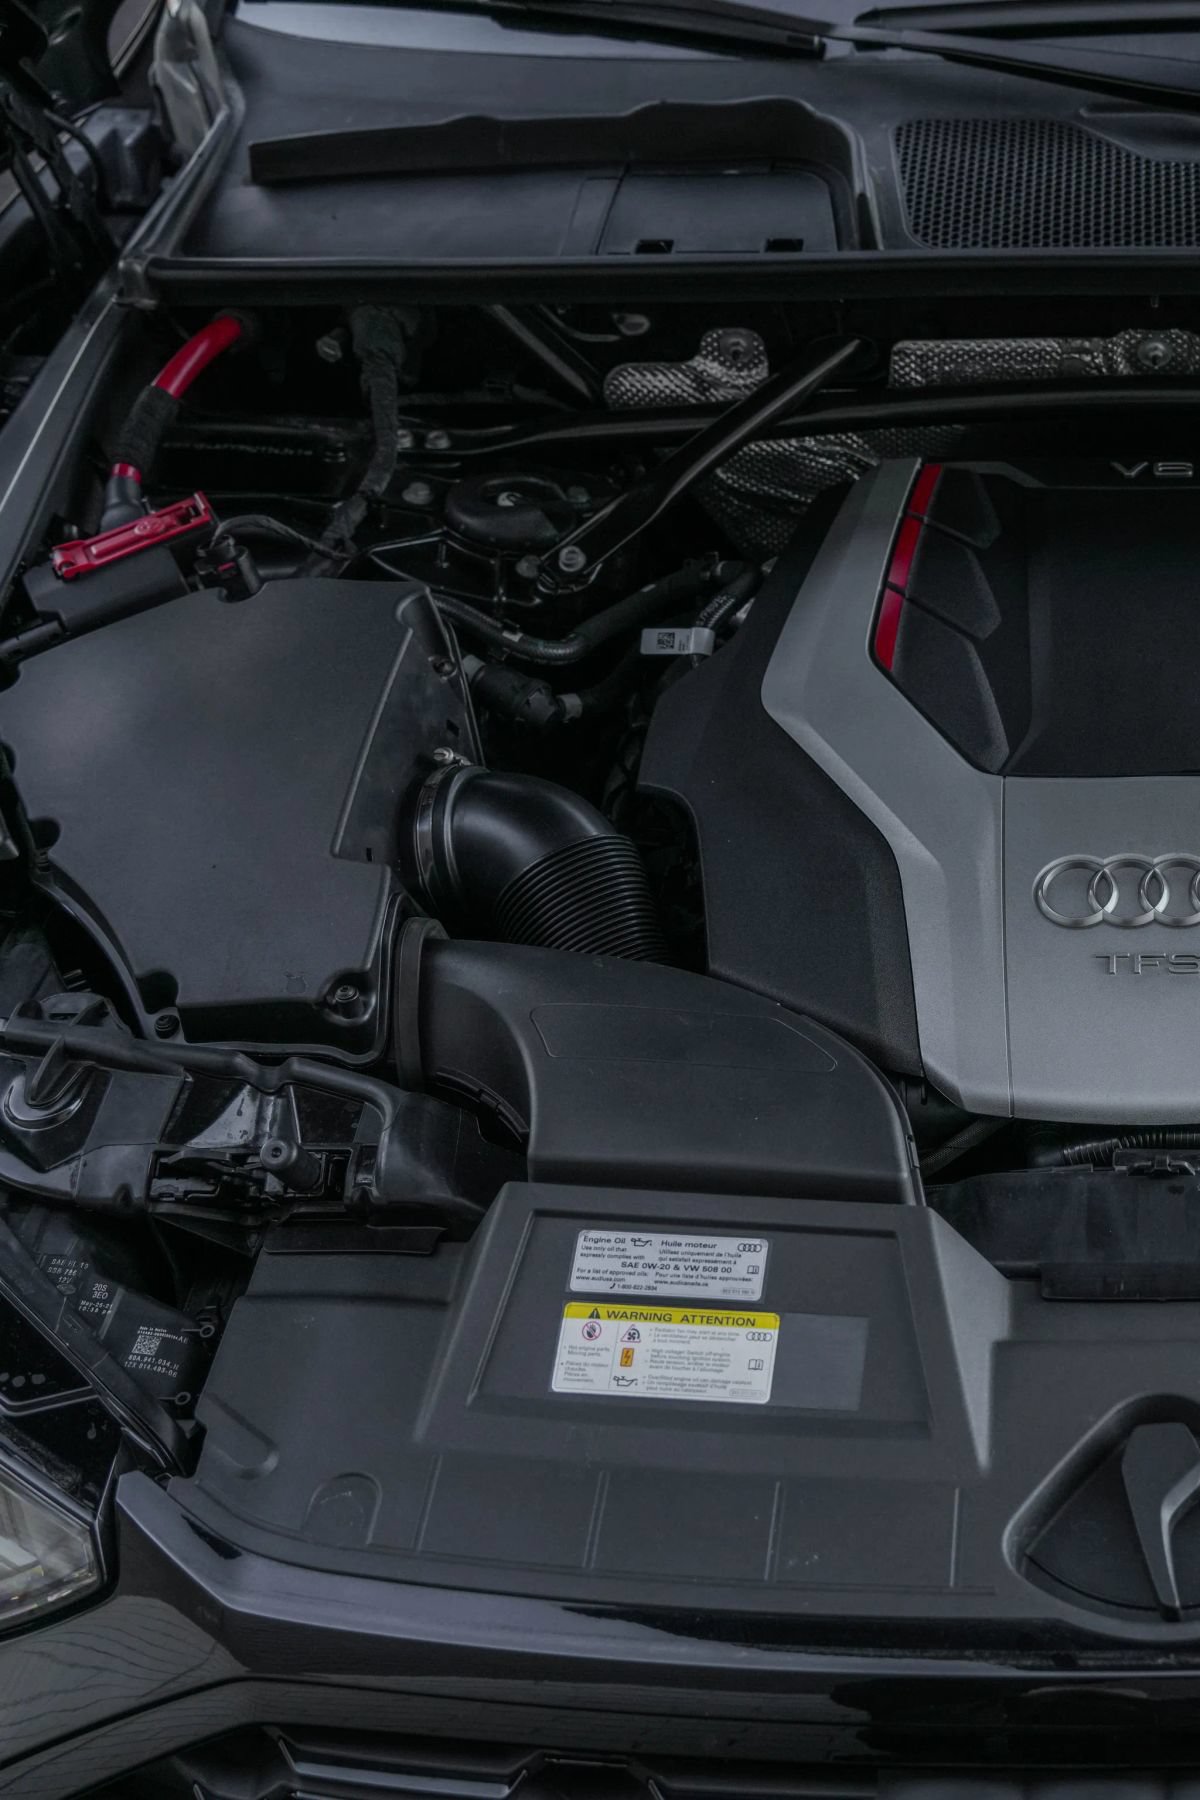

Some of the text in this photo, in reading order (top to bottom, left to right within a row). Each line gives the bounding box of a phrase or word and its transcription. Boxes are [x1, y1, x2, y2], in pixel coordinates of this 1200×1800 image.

[1110, 461, 1193, 478] V6
[583, 1235, 612, 1244] Engine
[661, 1240, 717, 1249] Huile moteur
[621, 1261, 639, 1269] SAE
[641, 1262, 671, 1271] 0W-20
[606, 1309, 757, 1327] WARNING ATTENTION
